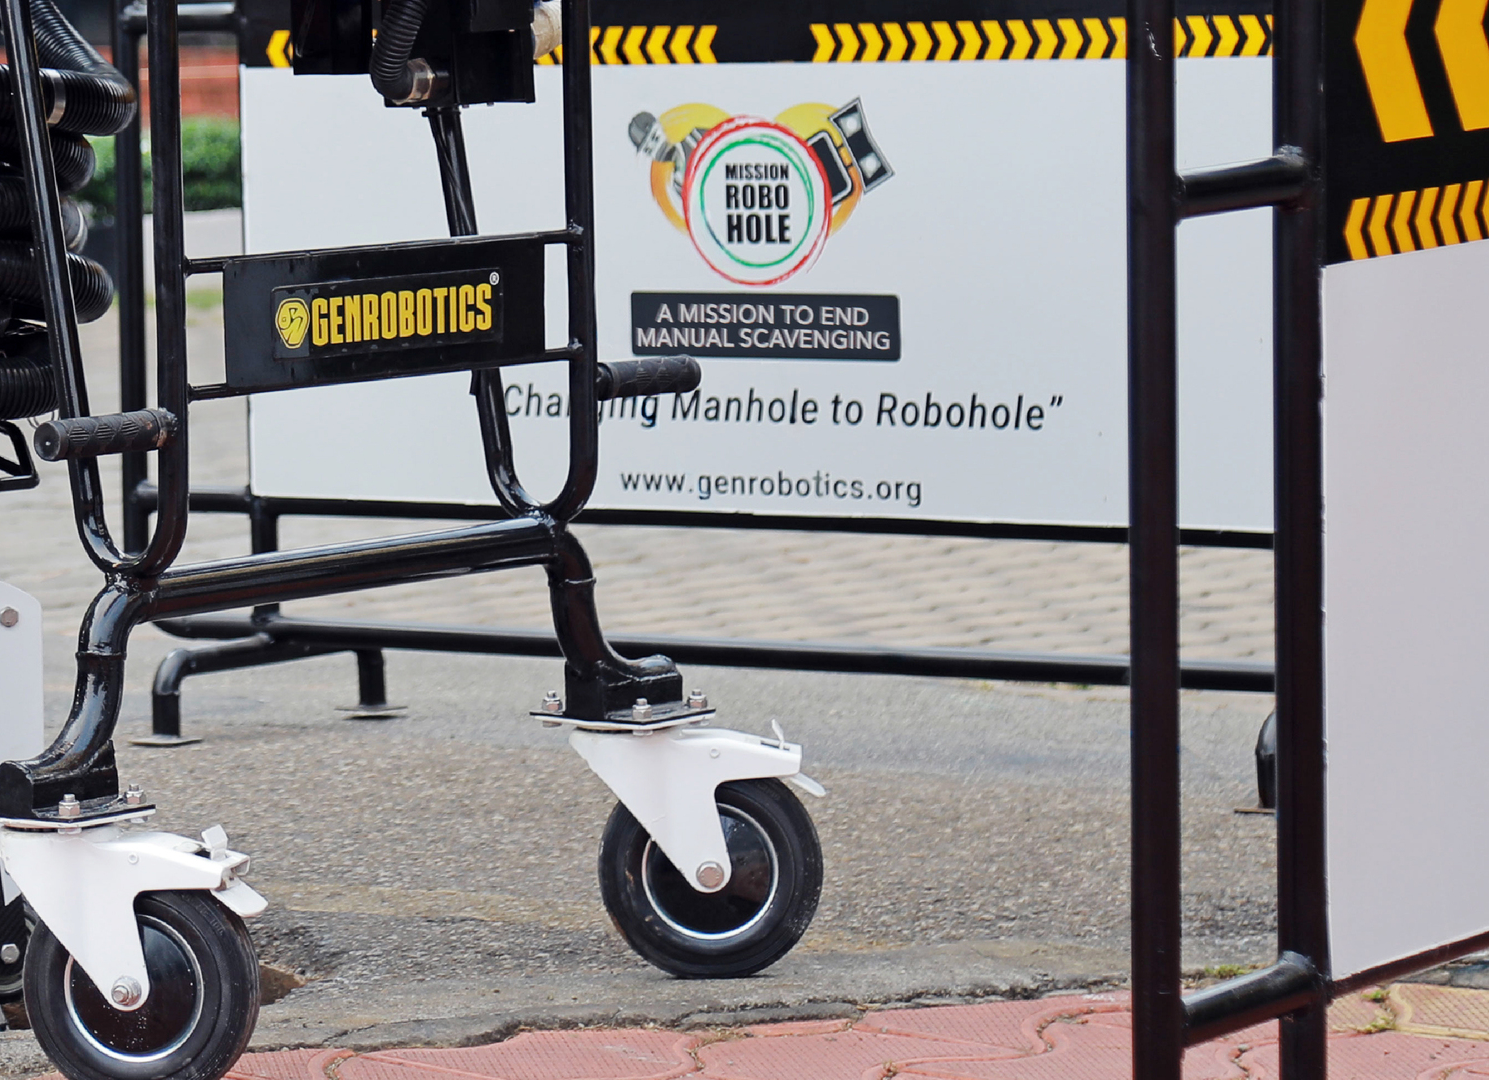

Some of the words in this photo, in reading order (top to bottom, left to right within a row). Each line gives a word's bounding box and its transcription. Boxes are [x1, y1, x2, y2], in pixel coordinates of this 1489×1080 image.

[725, 163, 789, 180] MISSION
[725, 184, 790, 210] ROBO
[726, 213, 792, 244] HOLE
[655, 303, 674, 323] A
[677, 303, 775, 324] MISSION
[779, 305, 814, 324] TO
[819, 307, 870, 326] END
[636, 327, 735, 348] MANUAL
[738, 329, 891, 350] SCAVENGING
[672, 388, 818, 425] Manhole
[831, 393, 864, 425] to
[621, 470, 922, 507] www.genrobotics.org
